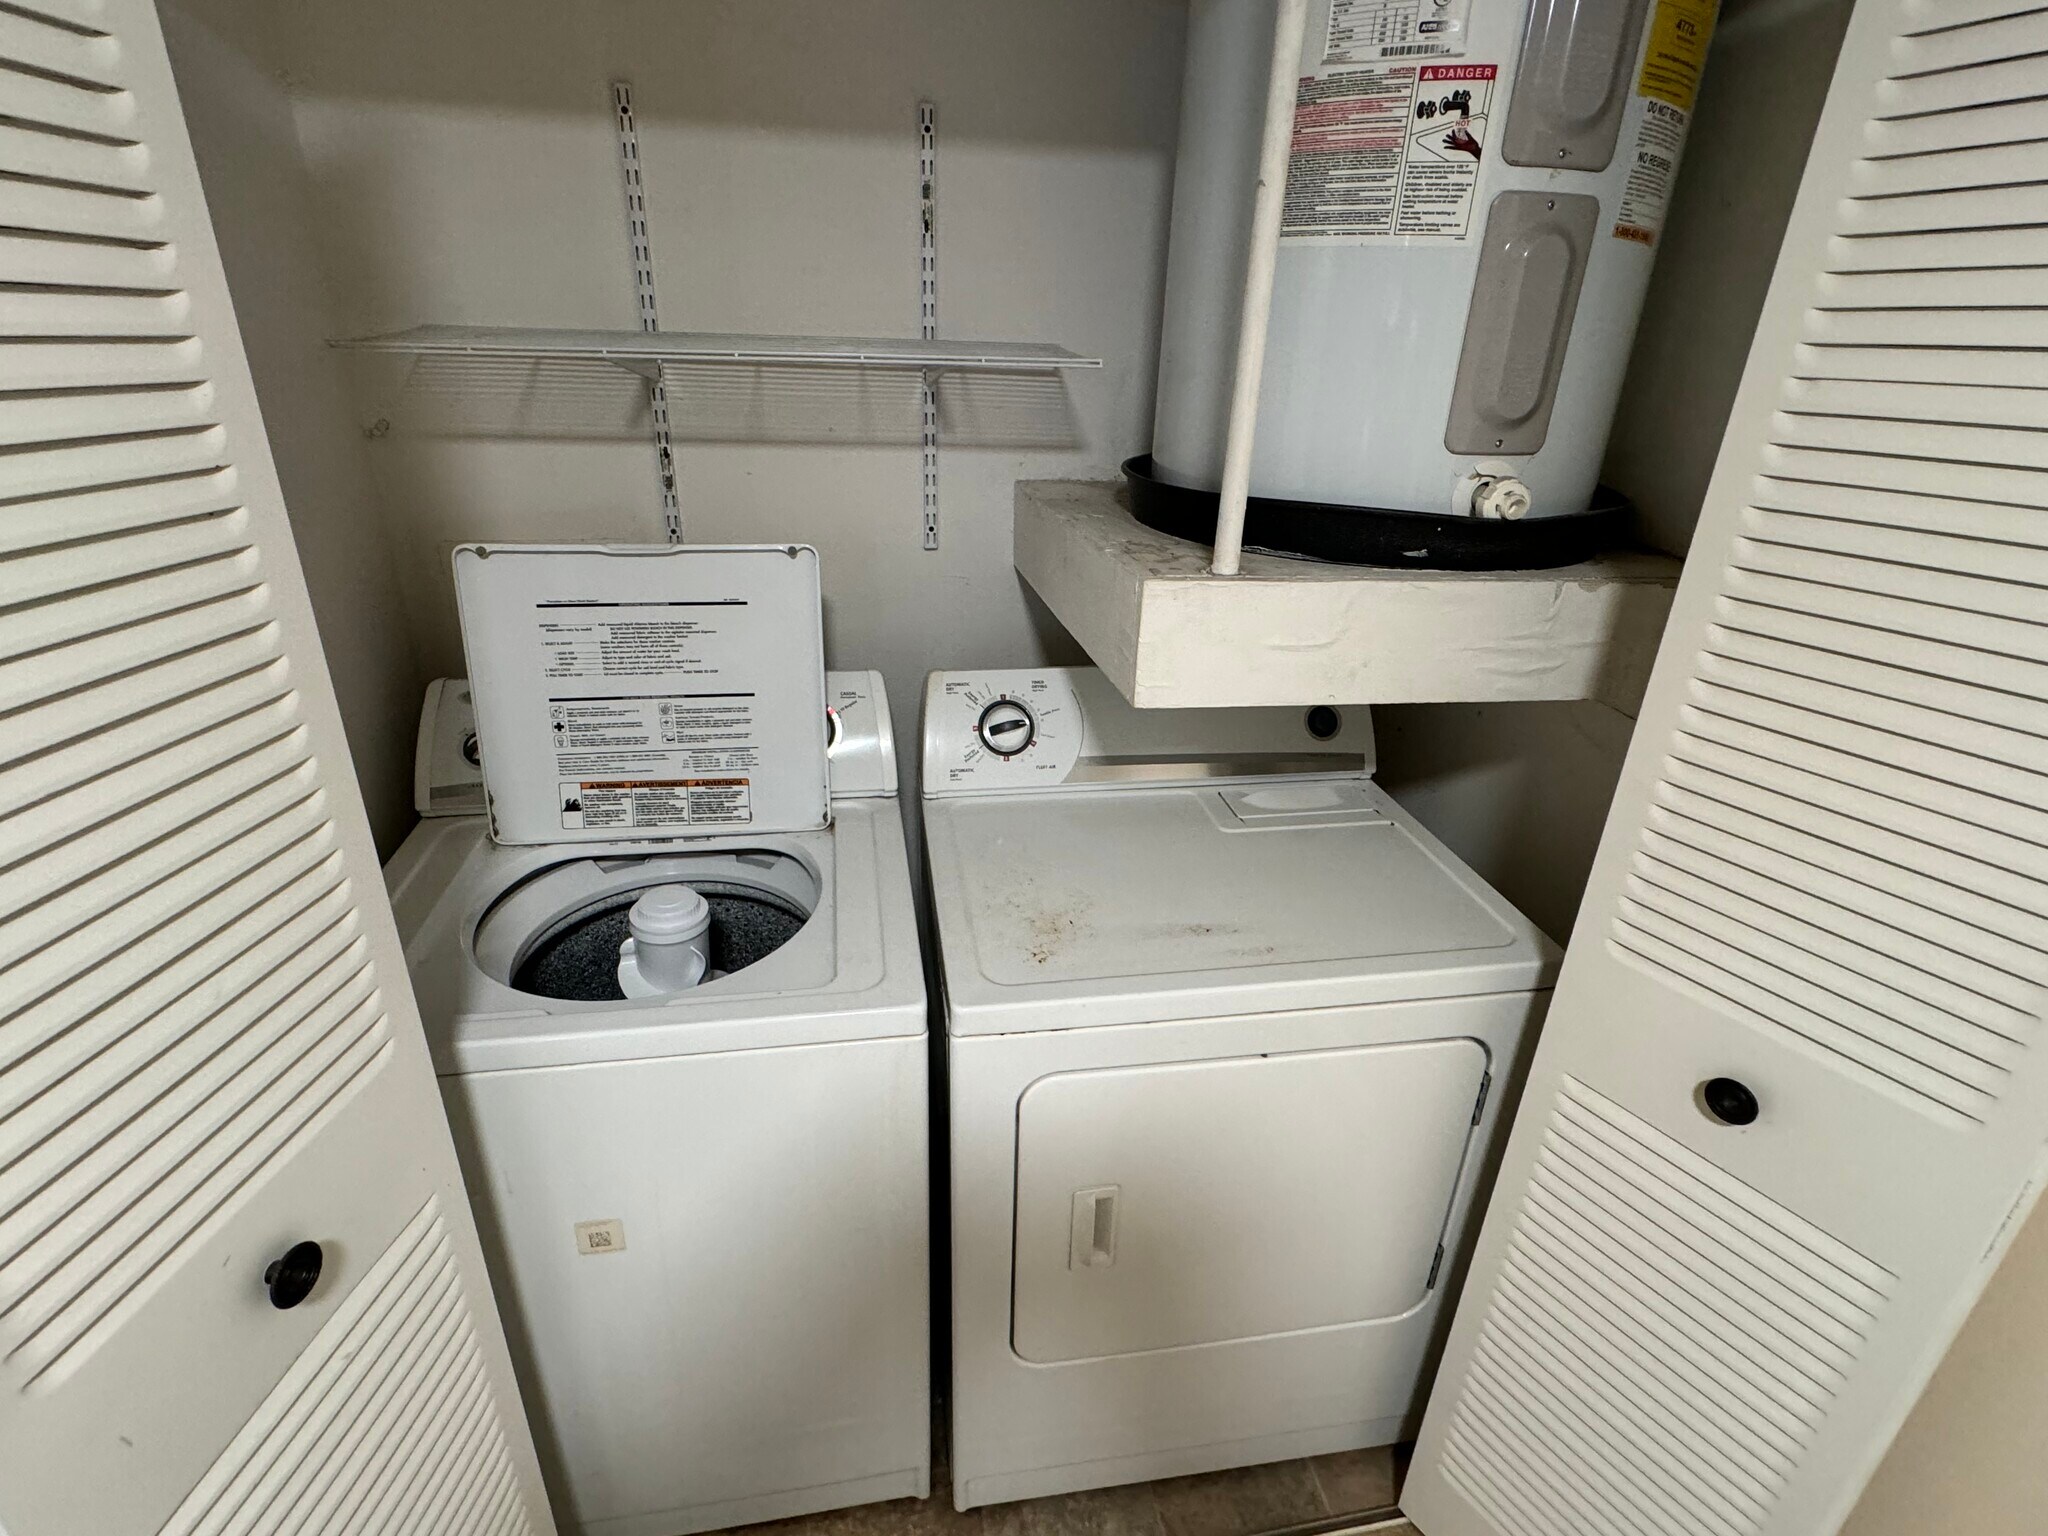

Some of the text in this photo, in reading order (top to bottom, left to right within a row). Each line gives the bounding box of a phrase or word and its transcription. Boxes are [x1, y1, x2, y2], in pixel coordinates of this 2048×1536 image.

[1438, 68, 1492, 78] DANGER
[1647, 101, 1657, 114] DO
[1658, 104, 1669, 116] NOT
